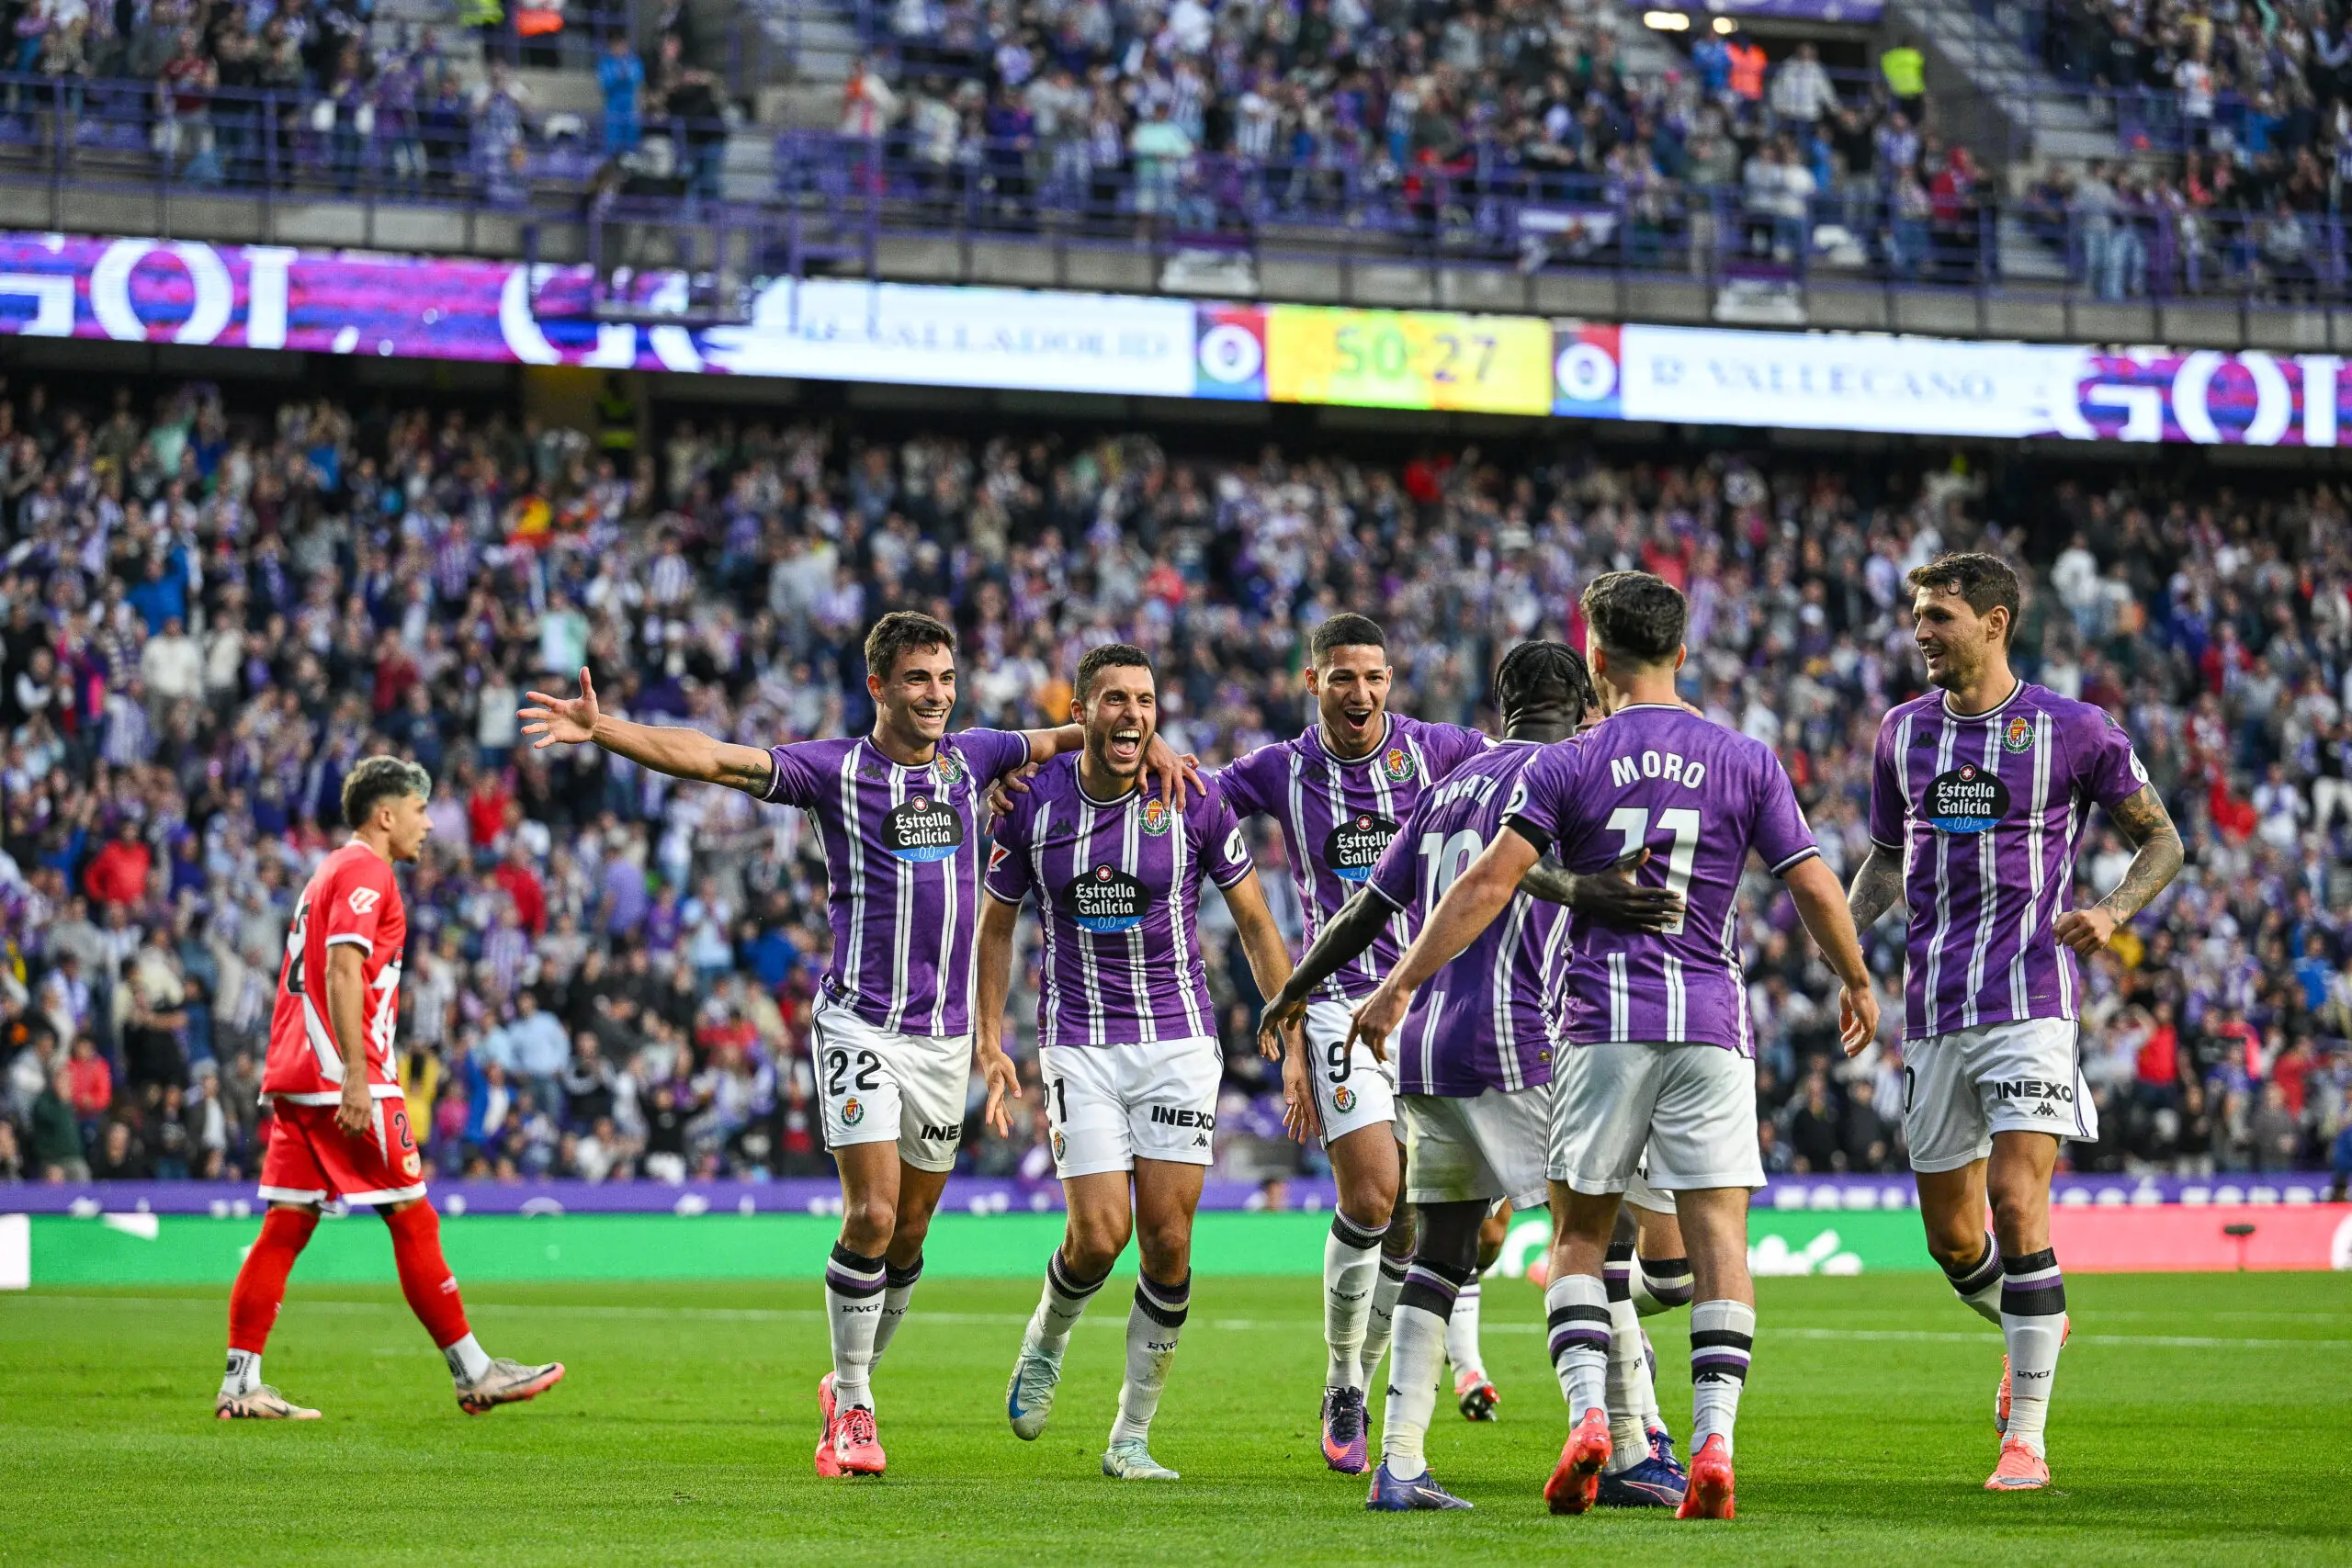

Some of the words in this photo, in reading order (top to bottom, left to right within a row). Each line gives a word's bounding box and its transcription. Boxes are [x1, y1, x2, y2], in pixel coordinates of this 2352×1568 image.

[1433, 333, 1497, 383] 27
[1611, 750, 1706, 789] MORO
[1936, 781, 1996, 798] Estrella
[1937, 797, 1992, 816] Galicia
[895, 811, 952, 830] Estrella
[899, 828, 951, 846] Galicia
[1340, 847, 1384, 865] Galic
[1605, 807, 1701, 935] 11
[1075, 883, 1136, 899] Estrella
[1078, 898, 1135, 915] Galicia
[830, 1050, 882, 1097] 22
[1327, 1041, 1351, 1084] 9
[1995, 1080, 2074, 1103] INEXO
[1150, 1105, 1216, 1132] INEXO
[921, 1120, 965, 1142] INE
